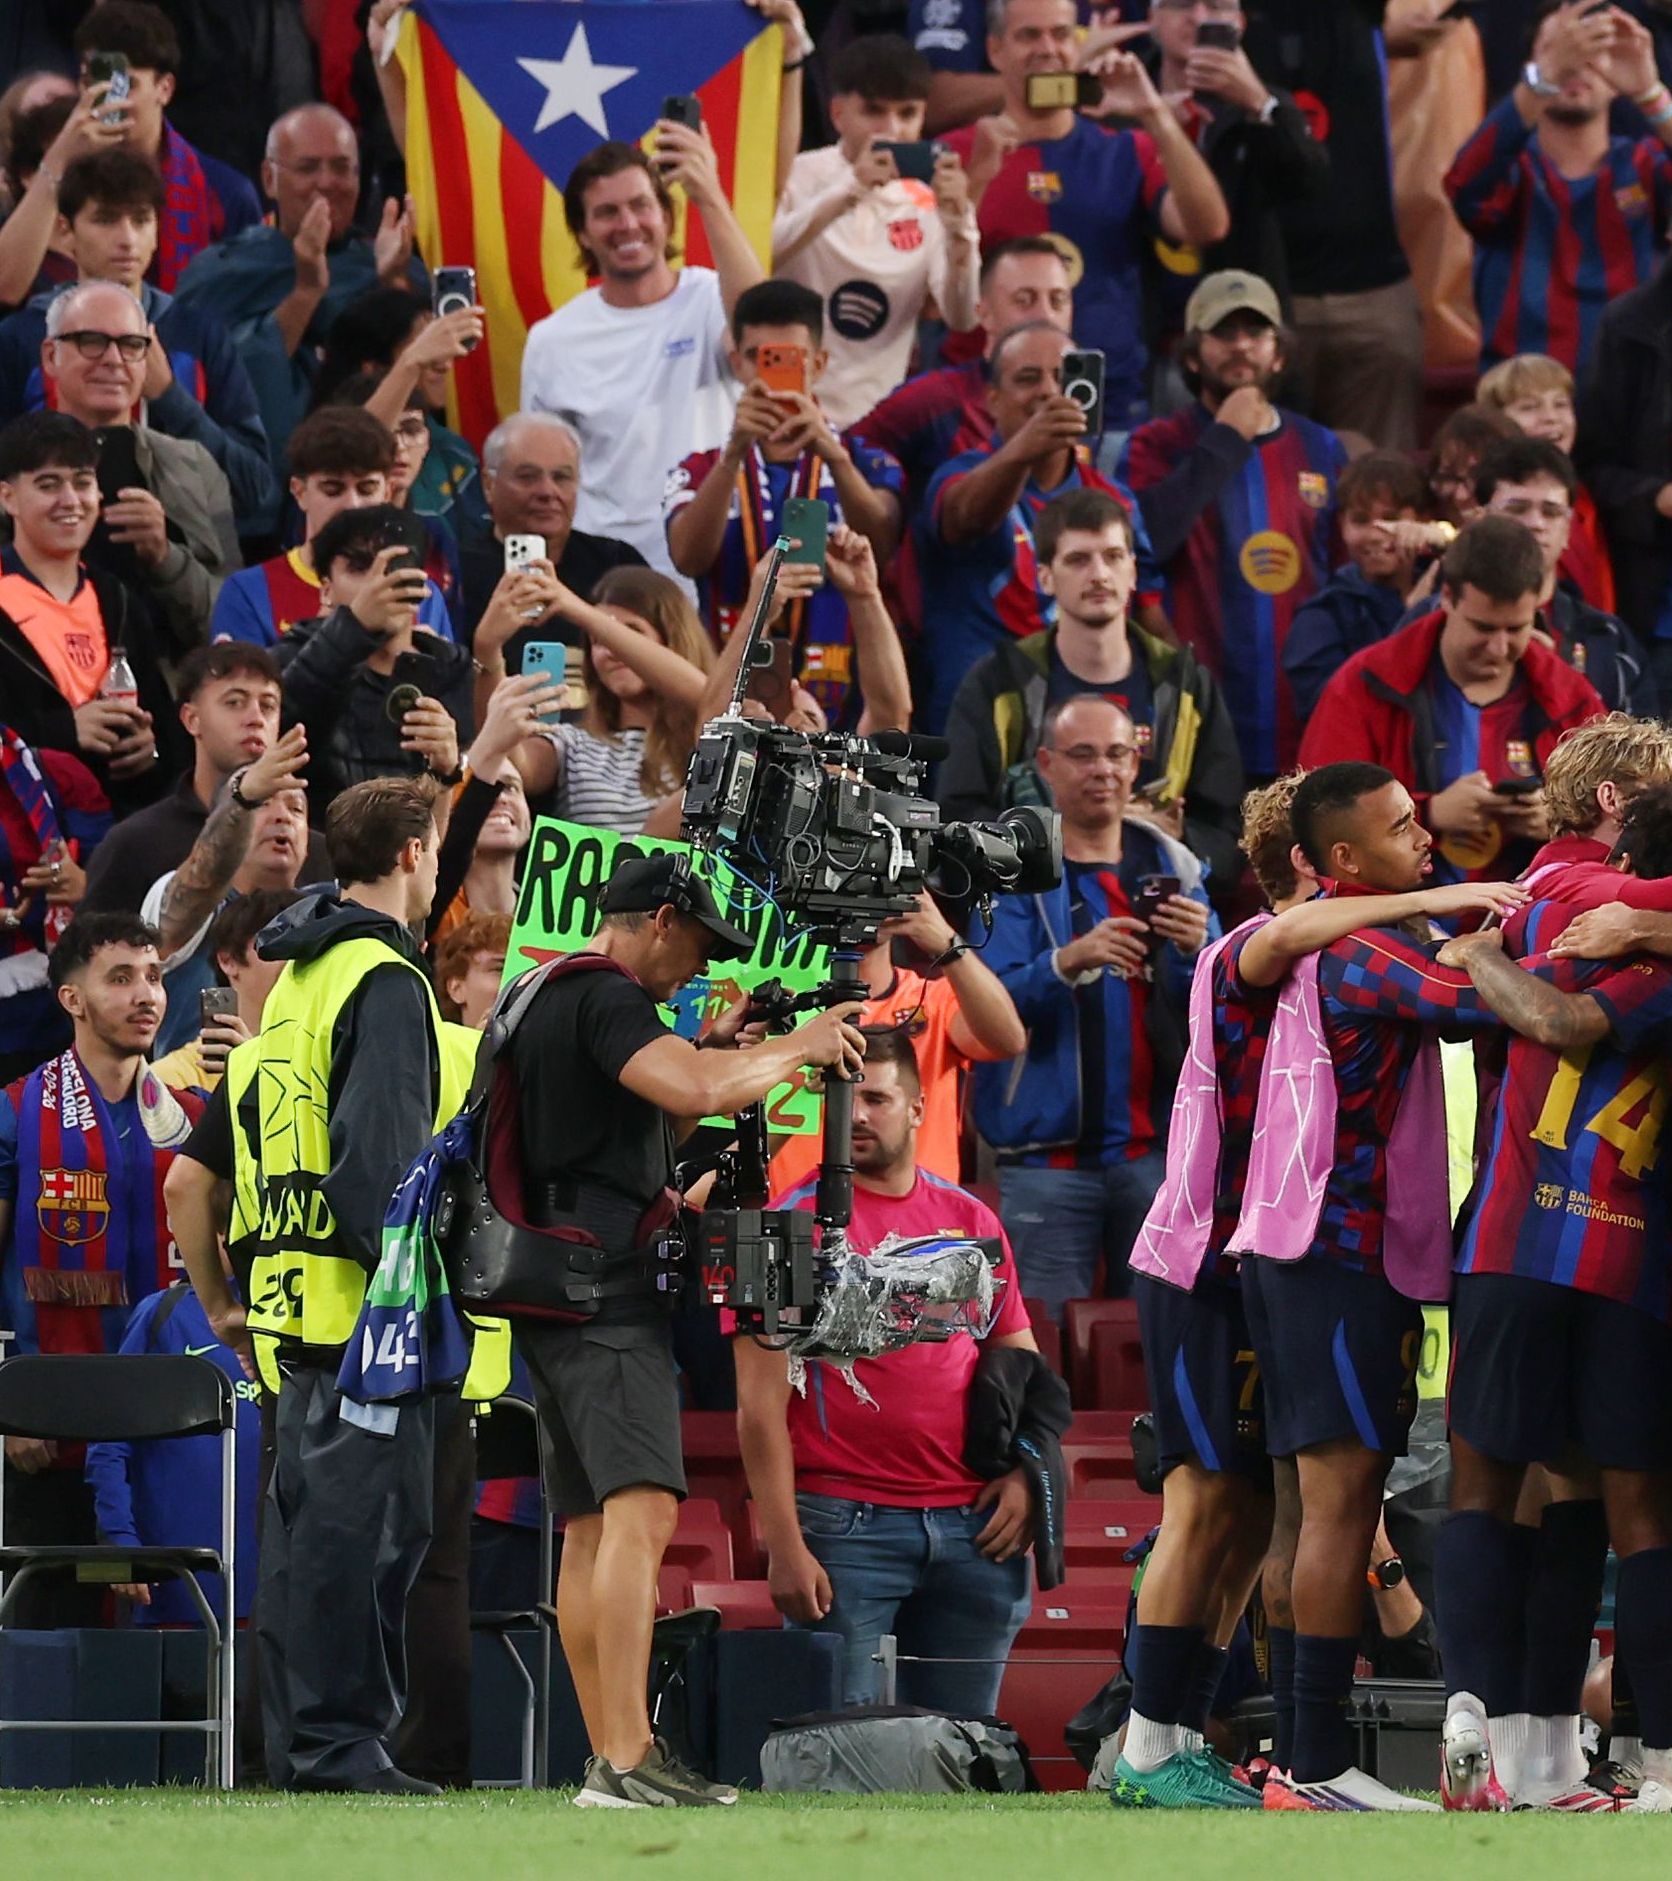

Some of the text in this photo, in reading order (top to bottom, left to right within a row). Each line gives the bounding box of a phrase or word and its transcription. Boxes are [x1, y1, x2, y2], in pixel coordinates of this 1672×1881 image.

[1529, 1046, 1670, 1182] 14
[58, 1200, 88, 1211] FCB
[1565, 1204, 1646, 1232] FOUNDATION
